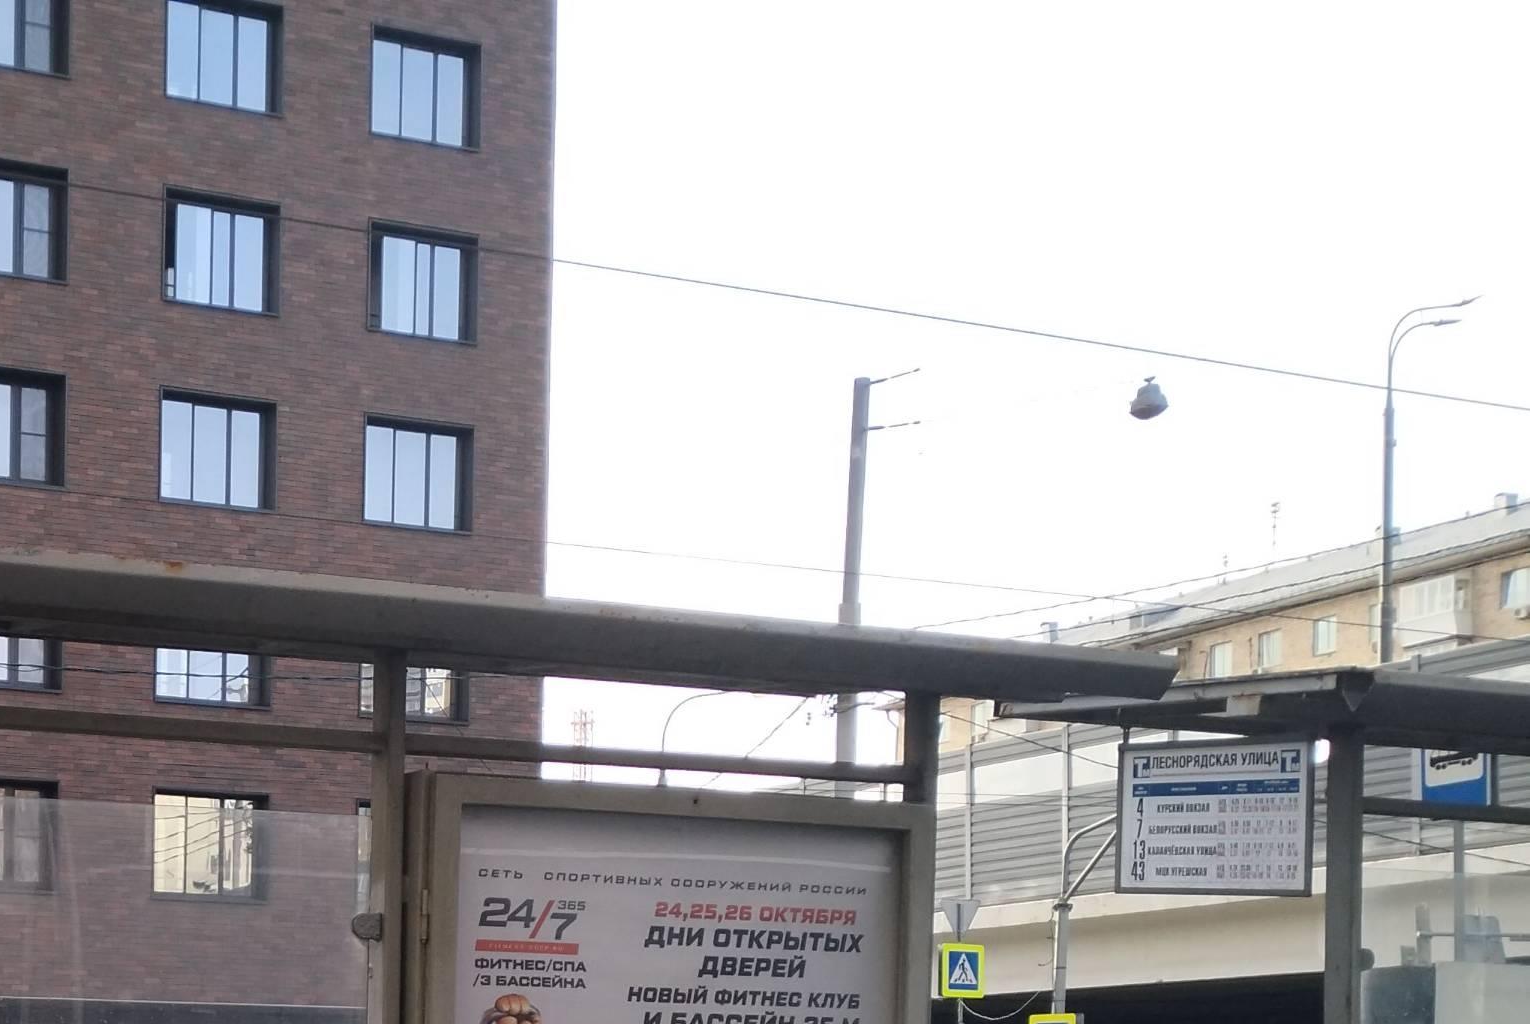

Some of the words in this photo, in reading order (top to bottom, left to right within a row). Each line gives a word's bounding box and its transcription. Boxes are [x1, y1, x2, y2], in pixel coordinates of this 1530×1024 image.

[1151, 754, 1237, 770] ЛЕСНОРЯДСКАЯ
[1240, 750, 1279, 768] УЛИЦА
[1136, 798, 1144, 817] 4
[1157, 802, 1184, 813] КУРСКИЙ
[1185, 802, 1210, 813] ВОКЗАЛ
[1137, 819, 1143, 838] 7
[1192, 824, 1218, 835] ВОКЗАЛ
[1133, 840, 1146, 859] 13
[1131, 862, 1145, 880] 43
[478, 868, 523, 880] СЕТЬ
[544, 871, 663, 887] СПОРТИВНЫХ
[671, 877, 791, 893] СООРУЖЕНИЙ
[799, 884, 867, 896] РОССИИ
[557, 899, 586, 911] 365
[655, 901, 752, 923] 24,25,26
[759, 906, 856, 926] ОКТЯБРЯ
[644, 925, 705, 948] ДНИ
[712, 928, 864, 953] ОТКРЫТЫХ
[475, 957, 587, 972] ФИТНЕС/СПА
[698, 955, 806, 979] ДВЕРЕЙ
[495, 975, 587, 989] БАССЕЙНА
[627, 985, 708, 1005] НОВЫЙ
[714, 989, 802, 1007] ФИТНЕС
[807, 993, 860, 1009] КЛУБ
